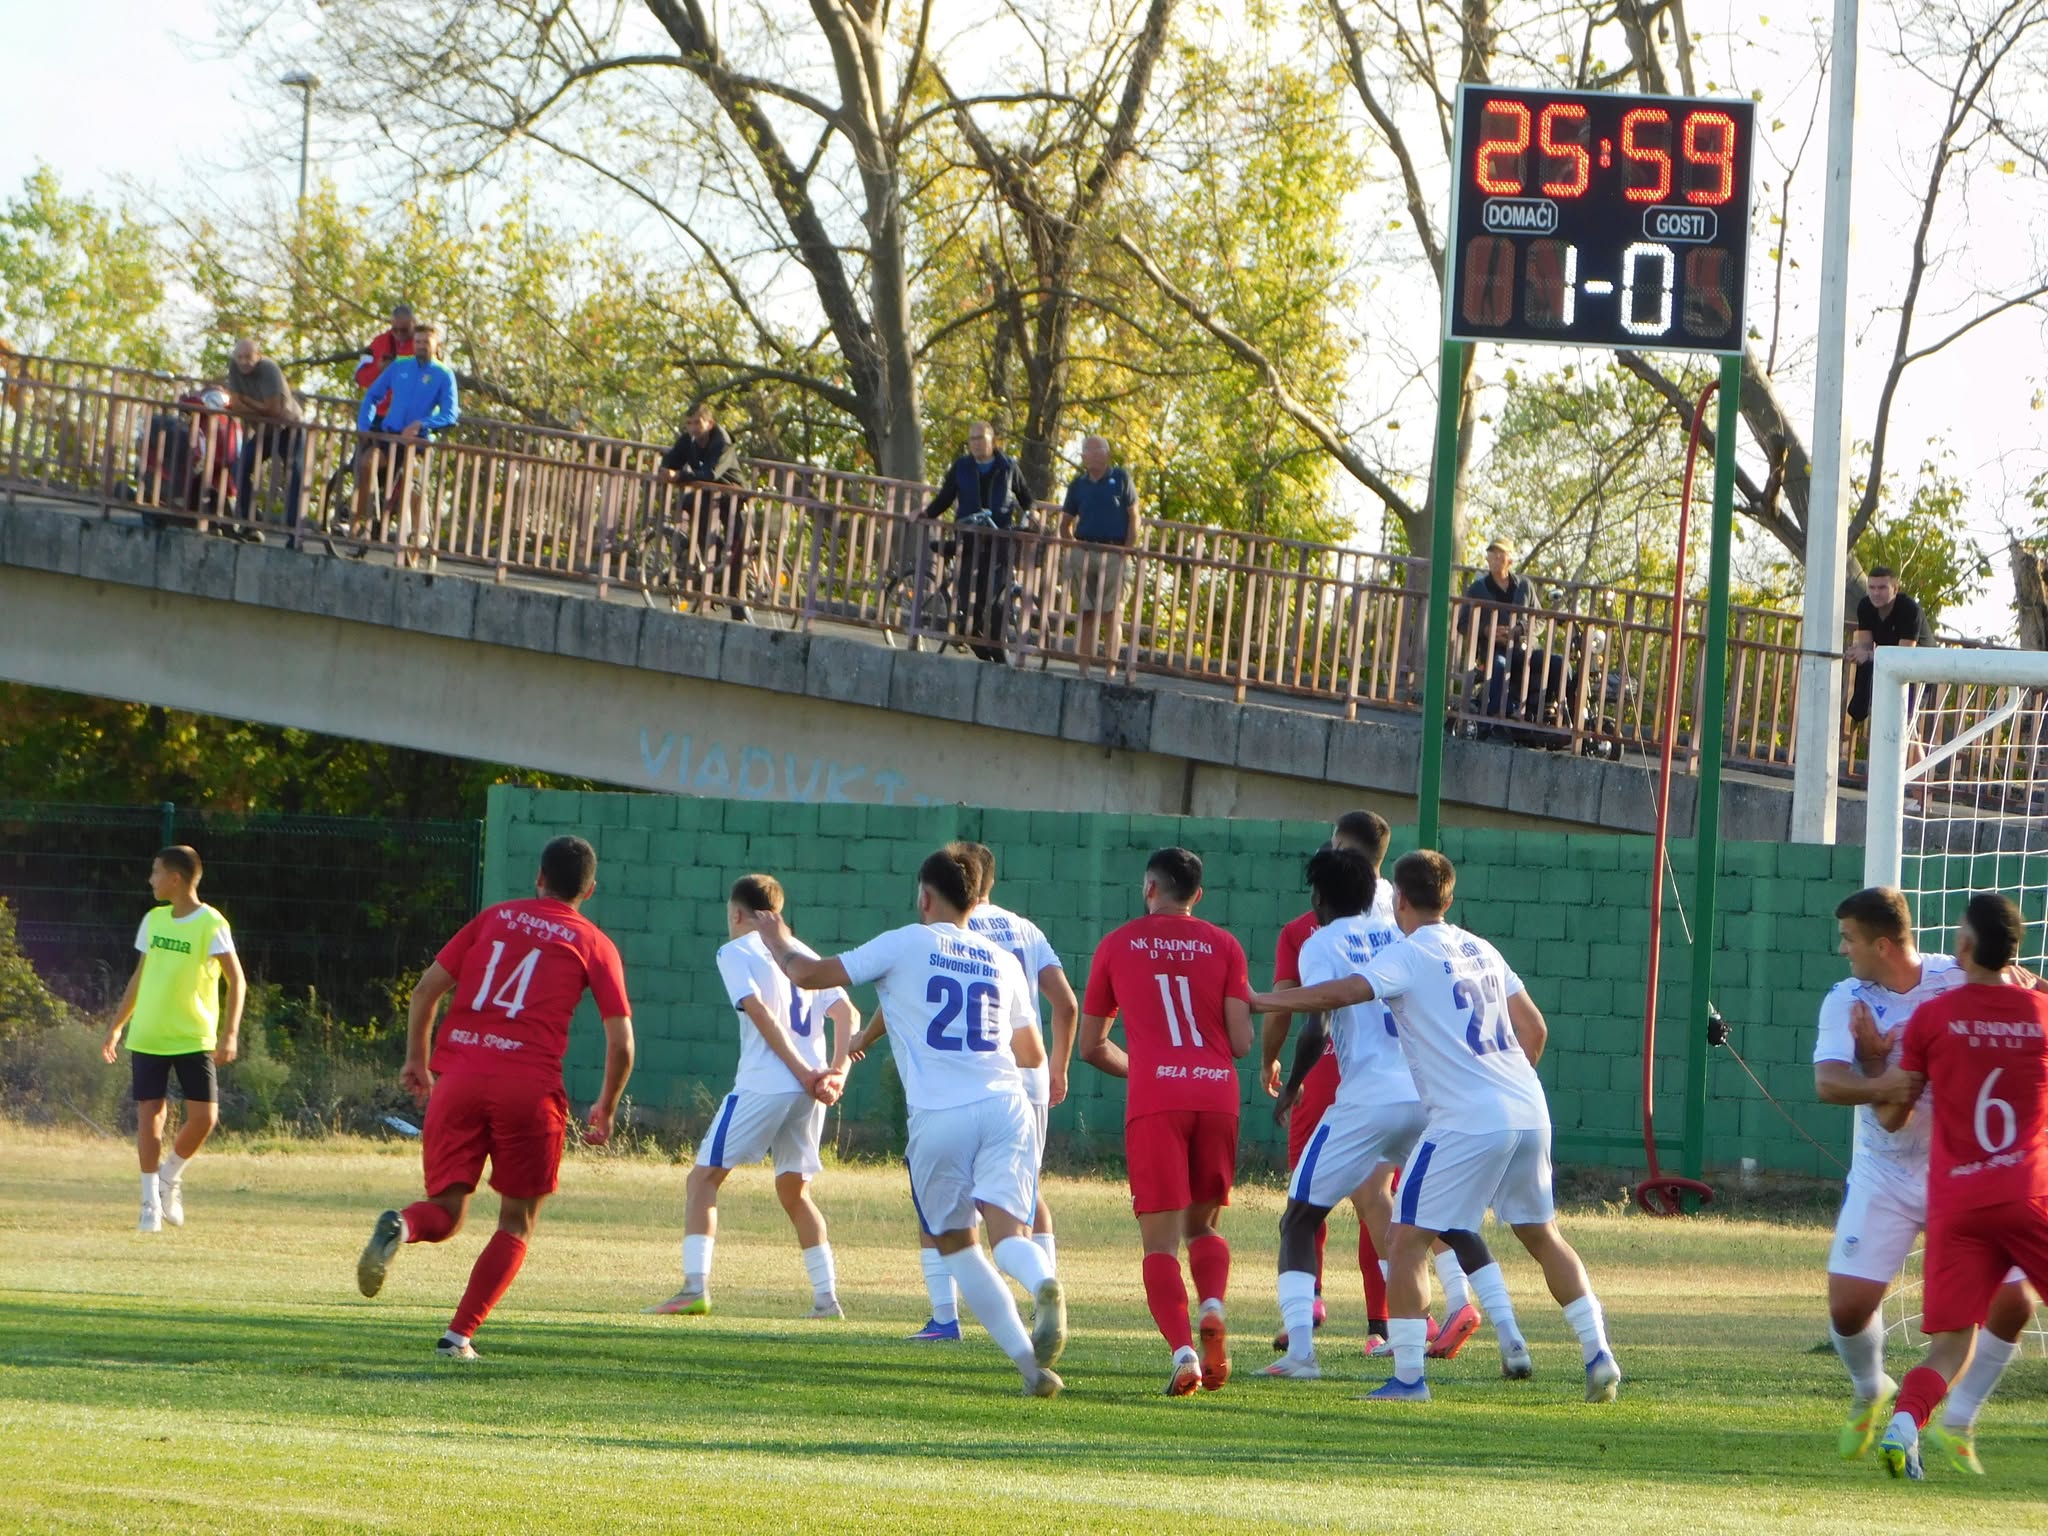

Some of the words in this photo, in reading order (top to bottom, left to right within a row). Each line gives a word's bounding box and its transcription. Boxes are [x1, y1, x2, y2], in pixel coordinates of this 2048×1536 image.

[1476, 100, 1735, 205] 25:59
[1656, 214, 1705, 236] GOSTI
[929, 953, 980, 975] Slavonski
[968, 945, 997, 965] BSK
[1130, 937, 1149, 950] NK
[471, 940, 542, 1019] 14
[926, 975, 1001, 1053] 20
[1154, 973, 1204, 1047] 11
[1192, 1066, 1231, 1082] SPORT
[1973, 1067, 2018, 1153] 6
